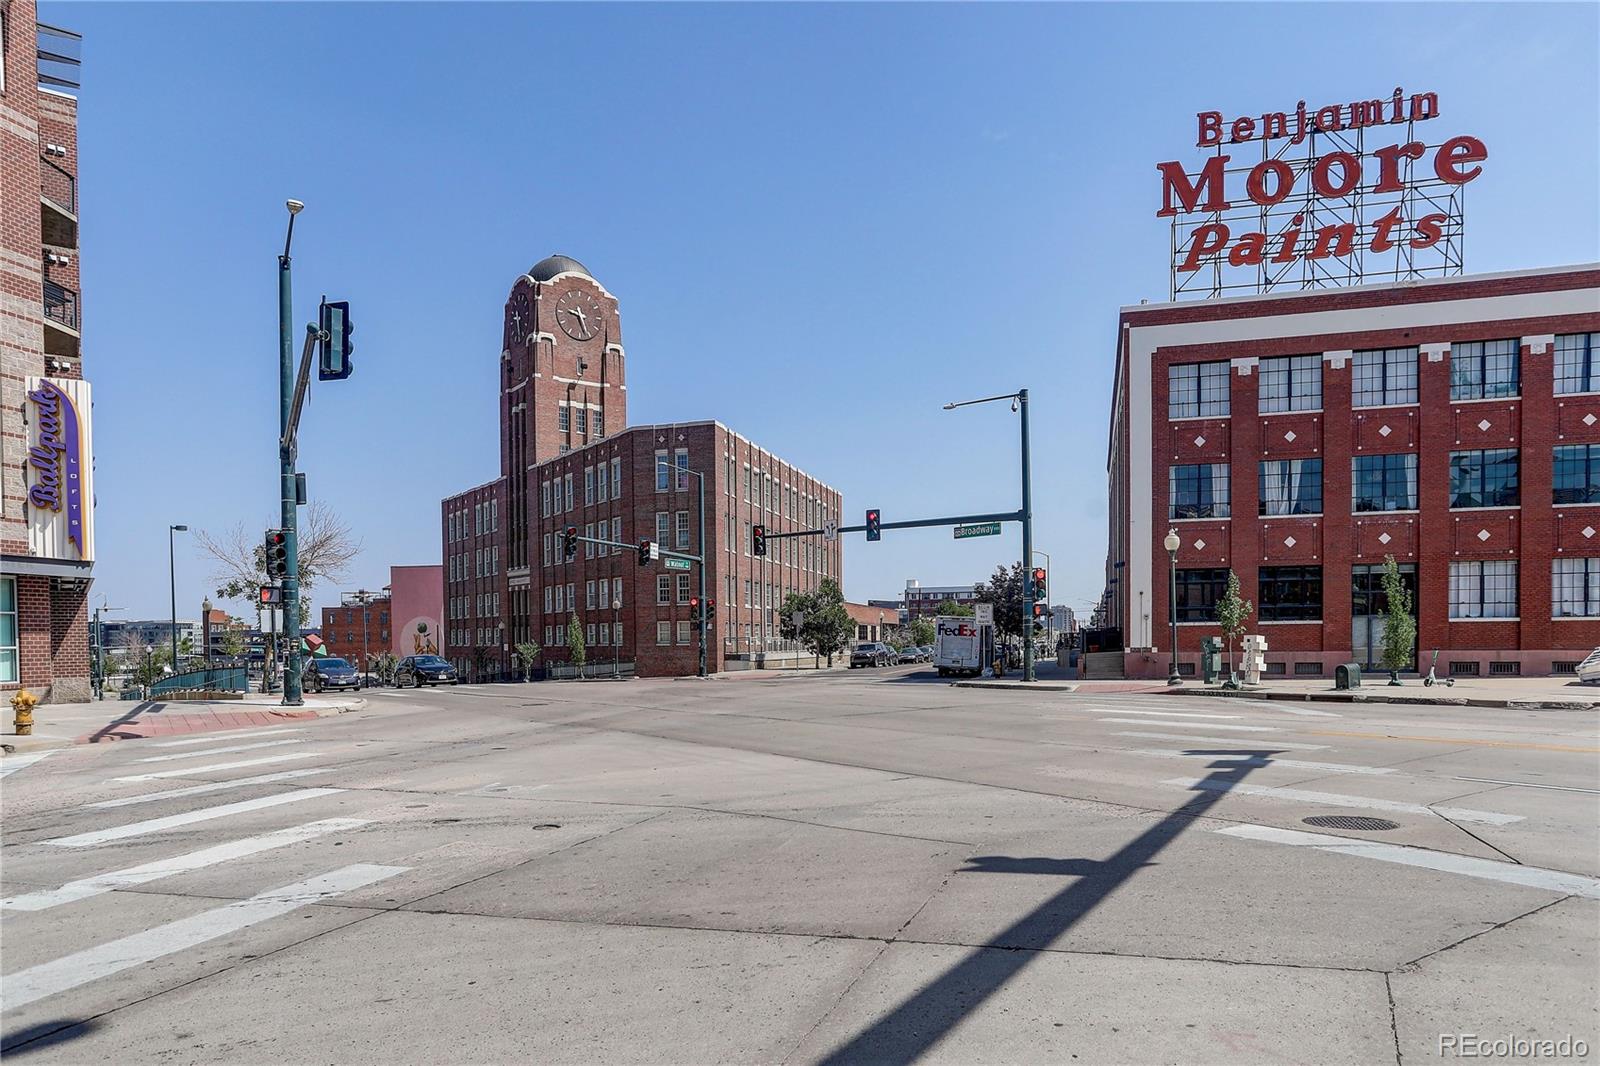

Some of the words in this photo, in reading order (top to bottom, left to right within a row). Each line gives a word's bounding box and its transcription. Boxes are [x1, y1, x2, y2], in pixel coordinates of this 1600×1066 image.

[1196, 87, 1440, 148] Benjamin
[1156, 135, 1488, 217] Moore
[1177, 206, 1449, 272] Paints
[28, 381, 66, 512] Ballpark
[70, 457, 79, 526] LOFTS
[959, 525, 994, 536] Broadway
[938, 623, 977, 637] FedEx
